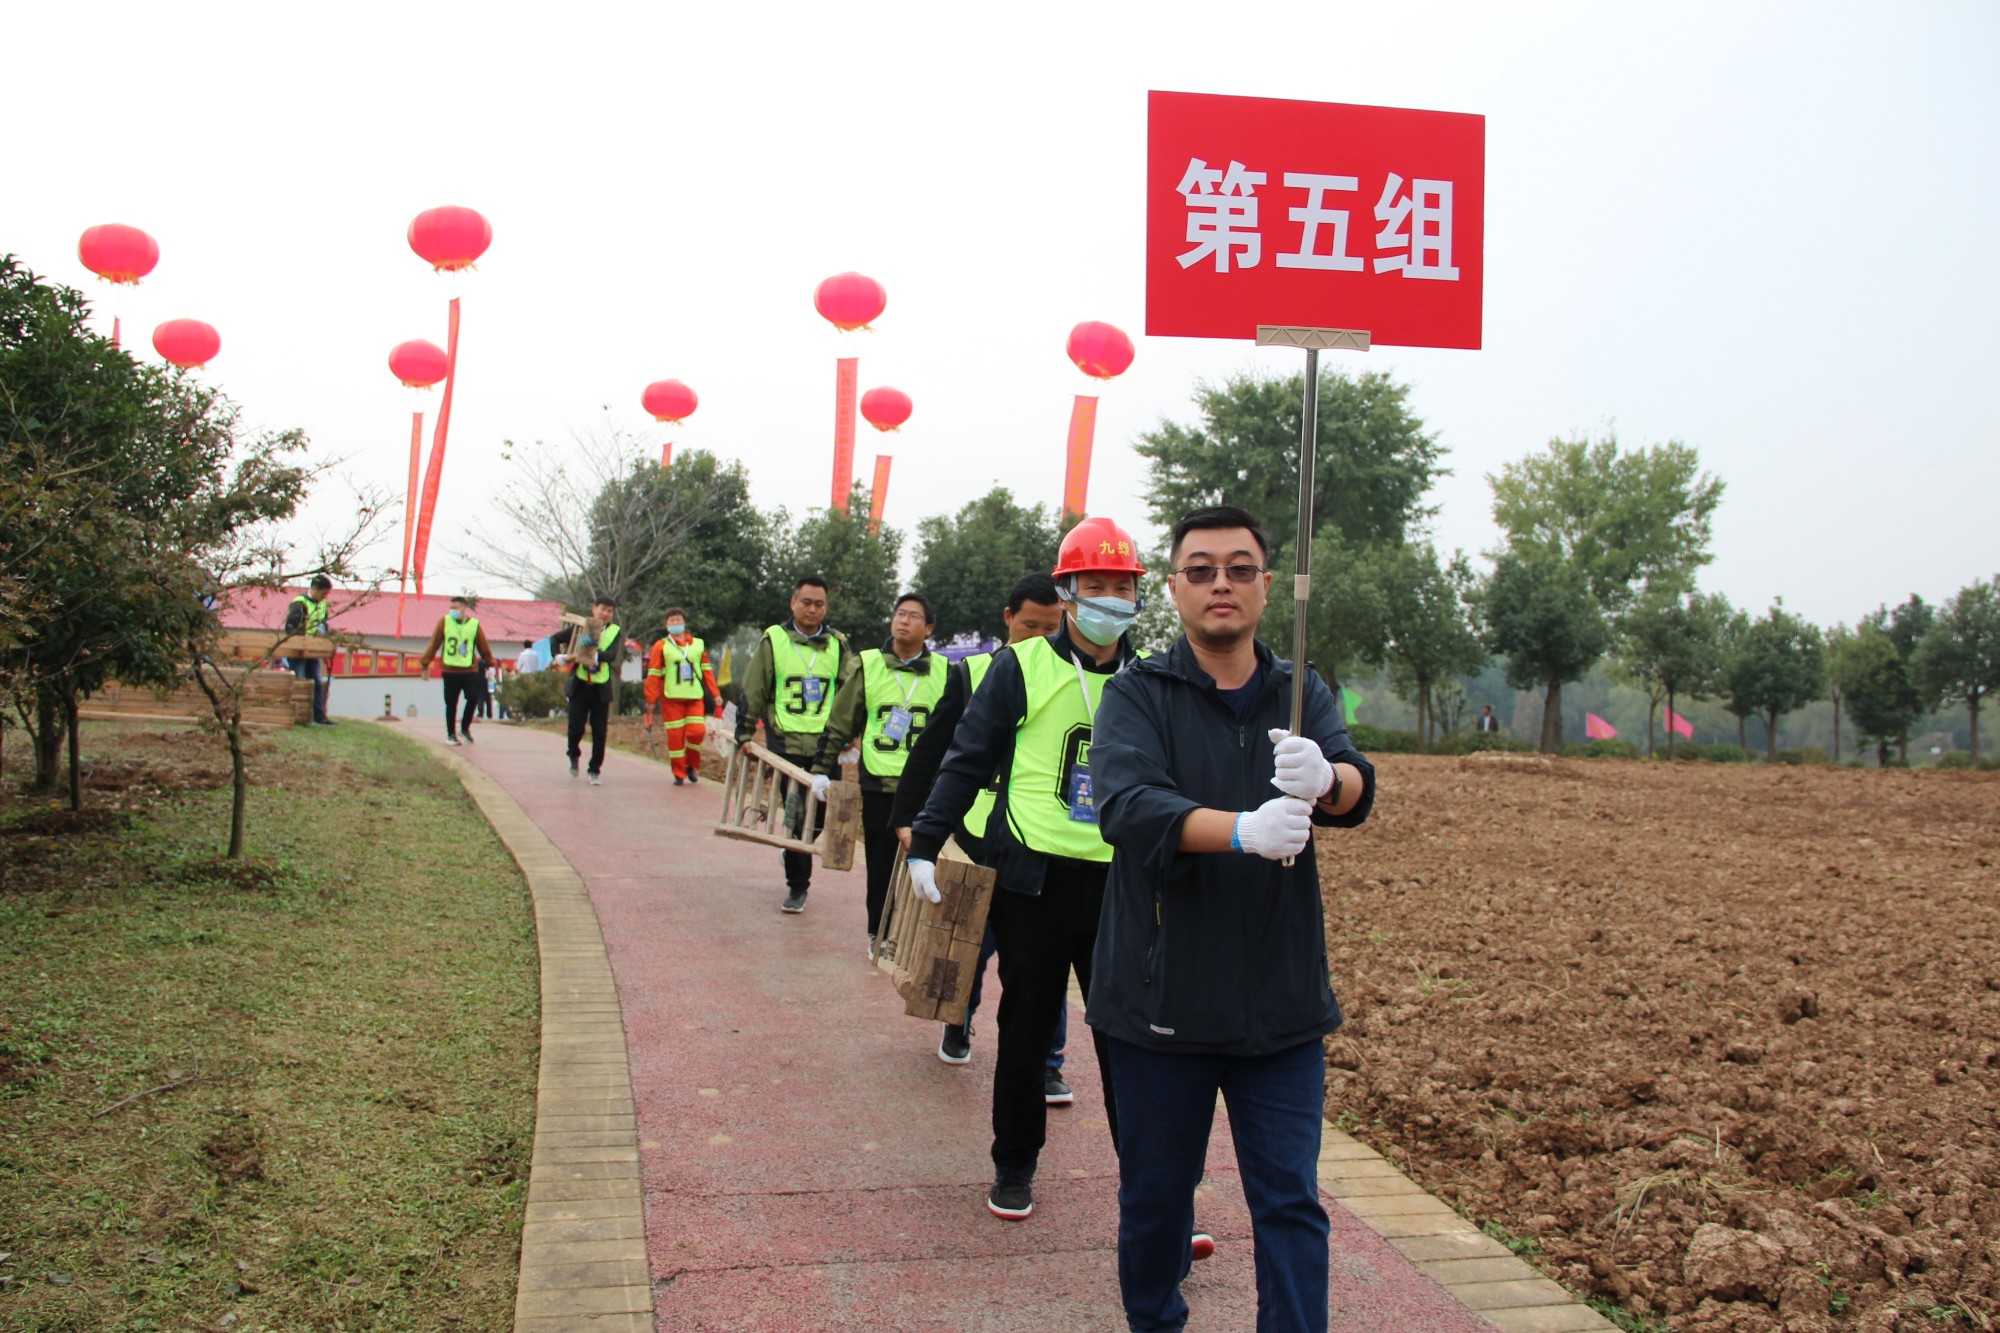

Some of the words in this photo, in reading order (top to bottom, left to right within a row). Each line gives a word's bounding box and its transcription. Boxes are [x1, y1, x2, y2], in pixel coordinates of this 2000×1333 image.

[1174, 156, 1461, 282] 第五组
[784, 675, 831, 715] 37
